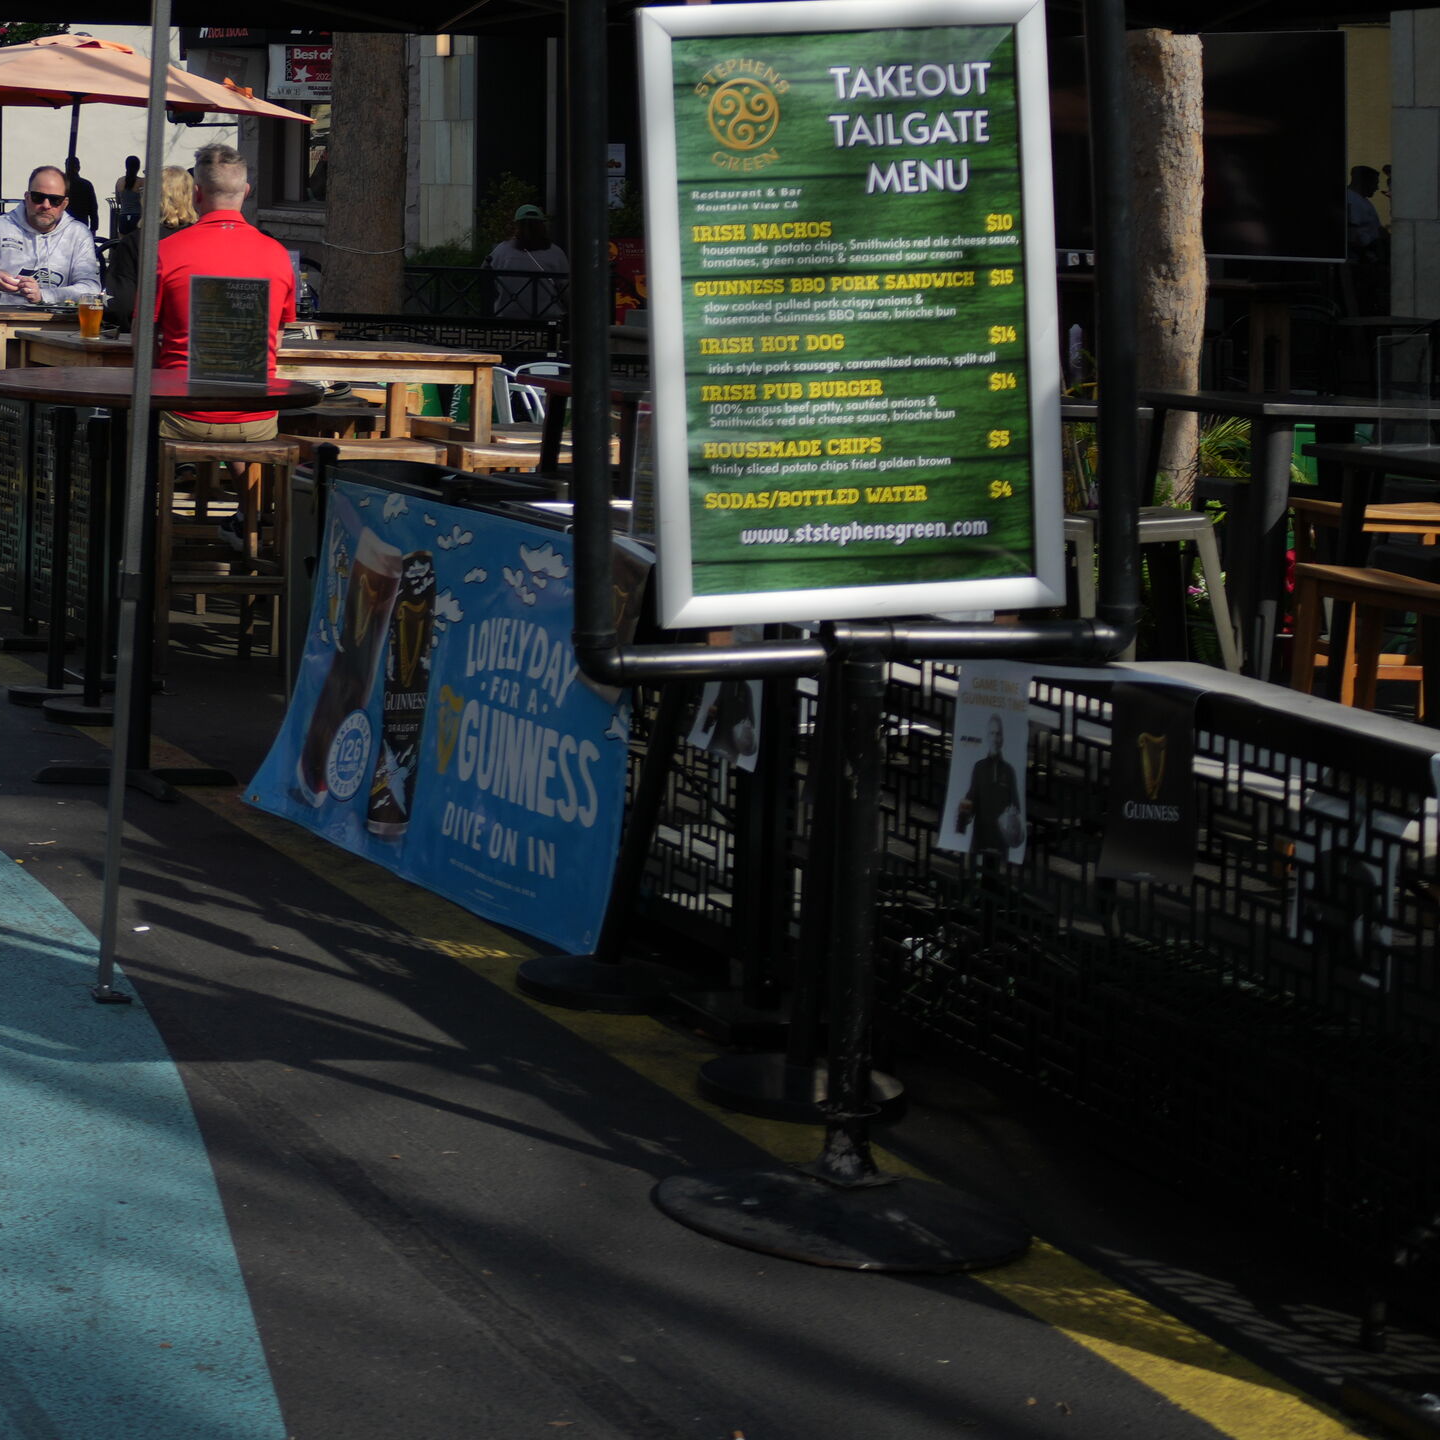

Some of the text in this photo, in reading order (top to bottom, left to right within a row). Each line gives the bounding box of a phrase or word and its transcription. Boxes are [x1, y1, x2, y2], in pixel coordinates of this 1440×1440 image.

[293, 48, 332, 60] Best of
[693, 59, 790, 98] STEPHENS
[828, 62, 991, 99] TAKEOUT
[828, 110, 990, 147] TAILGATE
[711, 147, 781, 172] GREEN
[867, 158, 969, 194] MENU
[692, 187, 802, 199] Restaurant & Bar
[696, 201, 798, 211] Mountain View CA
[692, 214, 1013, 242] IRISH NACHOS $10
[703, 235, 1019, 256] housemade potato chips, Smithwicks red ale cheese sauce,
[703, 250, 963, 268] tomatoes, green onions & seasoned sour cream
[227, 282, 259, 291] TAKEOUT
[694, 269, 1014, 296] GUINNESS BBQ PORK SANDWICH $15
[232, 302, 254, 310] MENU
[704, 294, 924, 313] slow cooked pulled pork crispy onions &
[705, 307, 957, 325] housemade Guinness BBQ sauce, brioche bun
[700, 325, 1016, 354] IRISH HOT DOG $14
[708, 351, 996, 376] irish style pork sausage, caramelized onions, split roll
[701, 372, 1017, 402] IRISH PUB BURGER $14
[710, 395, 937, 417] 100% angus beef patty, sautéed onions &
[710, 409, 955, 427] Smithwicks red ale cheese sauce, brioche bun
[703, 429, 1011, 459] HOUSEMADE CHIPS $5
[711, 456, 951, 477] thinly sliced potato chips fried golden brown
[704, 480, 1012, 510] SODAS/BOTTLED WATER $4
[741, 520, 988, 547] www.ststephensgreen.com
[466, 618, 580, 708] LOVELY DAY
[384, 691, 426, 710] GUINNESS
[490, 676, 538, 715] FOR A
[339, 738, 363, 762] 126
[458, 699, 601, 828] GUINNESS
[1124, 800, 1180, 822] GUINNESS
[441, 801, 486, 851] DIVE
[489, 822, 518, 866] ON
[528, 836, 555, 879] IN
